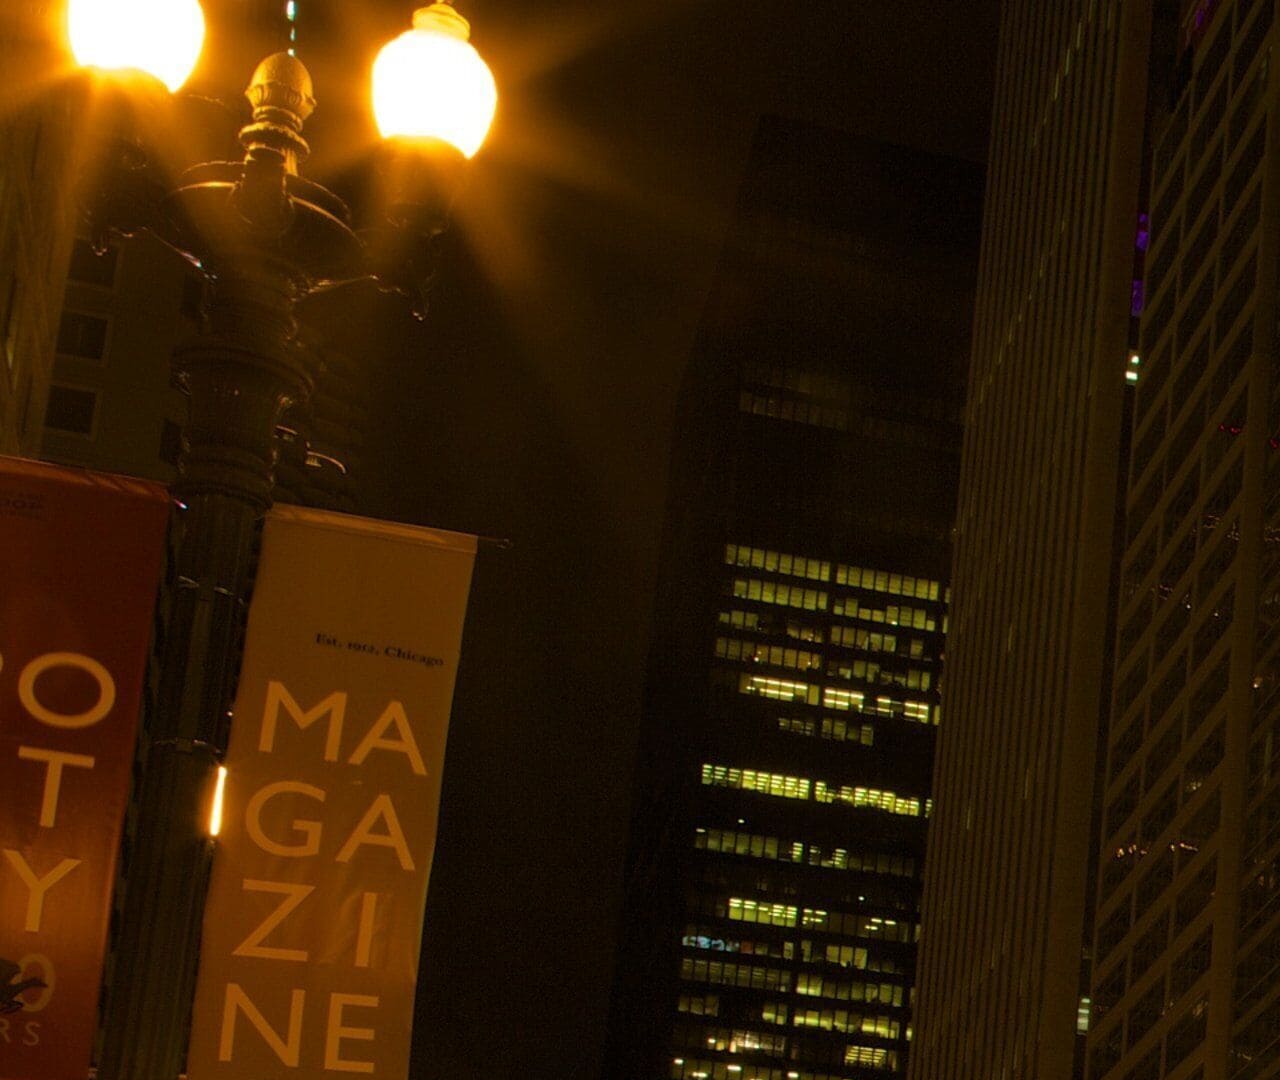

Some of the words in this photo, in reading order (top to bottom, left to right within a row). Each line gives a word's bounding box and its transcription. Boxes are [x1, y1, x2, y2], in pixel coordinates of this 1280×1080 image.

[384, 645, 445, 667] Chicago
[257, 680, 428, 777] MA
[245, 781, 415, 872] GA
[231, 878, 379, 968] ZI
[218, 982, 380, 1074] NE
